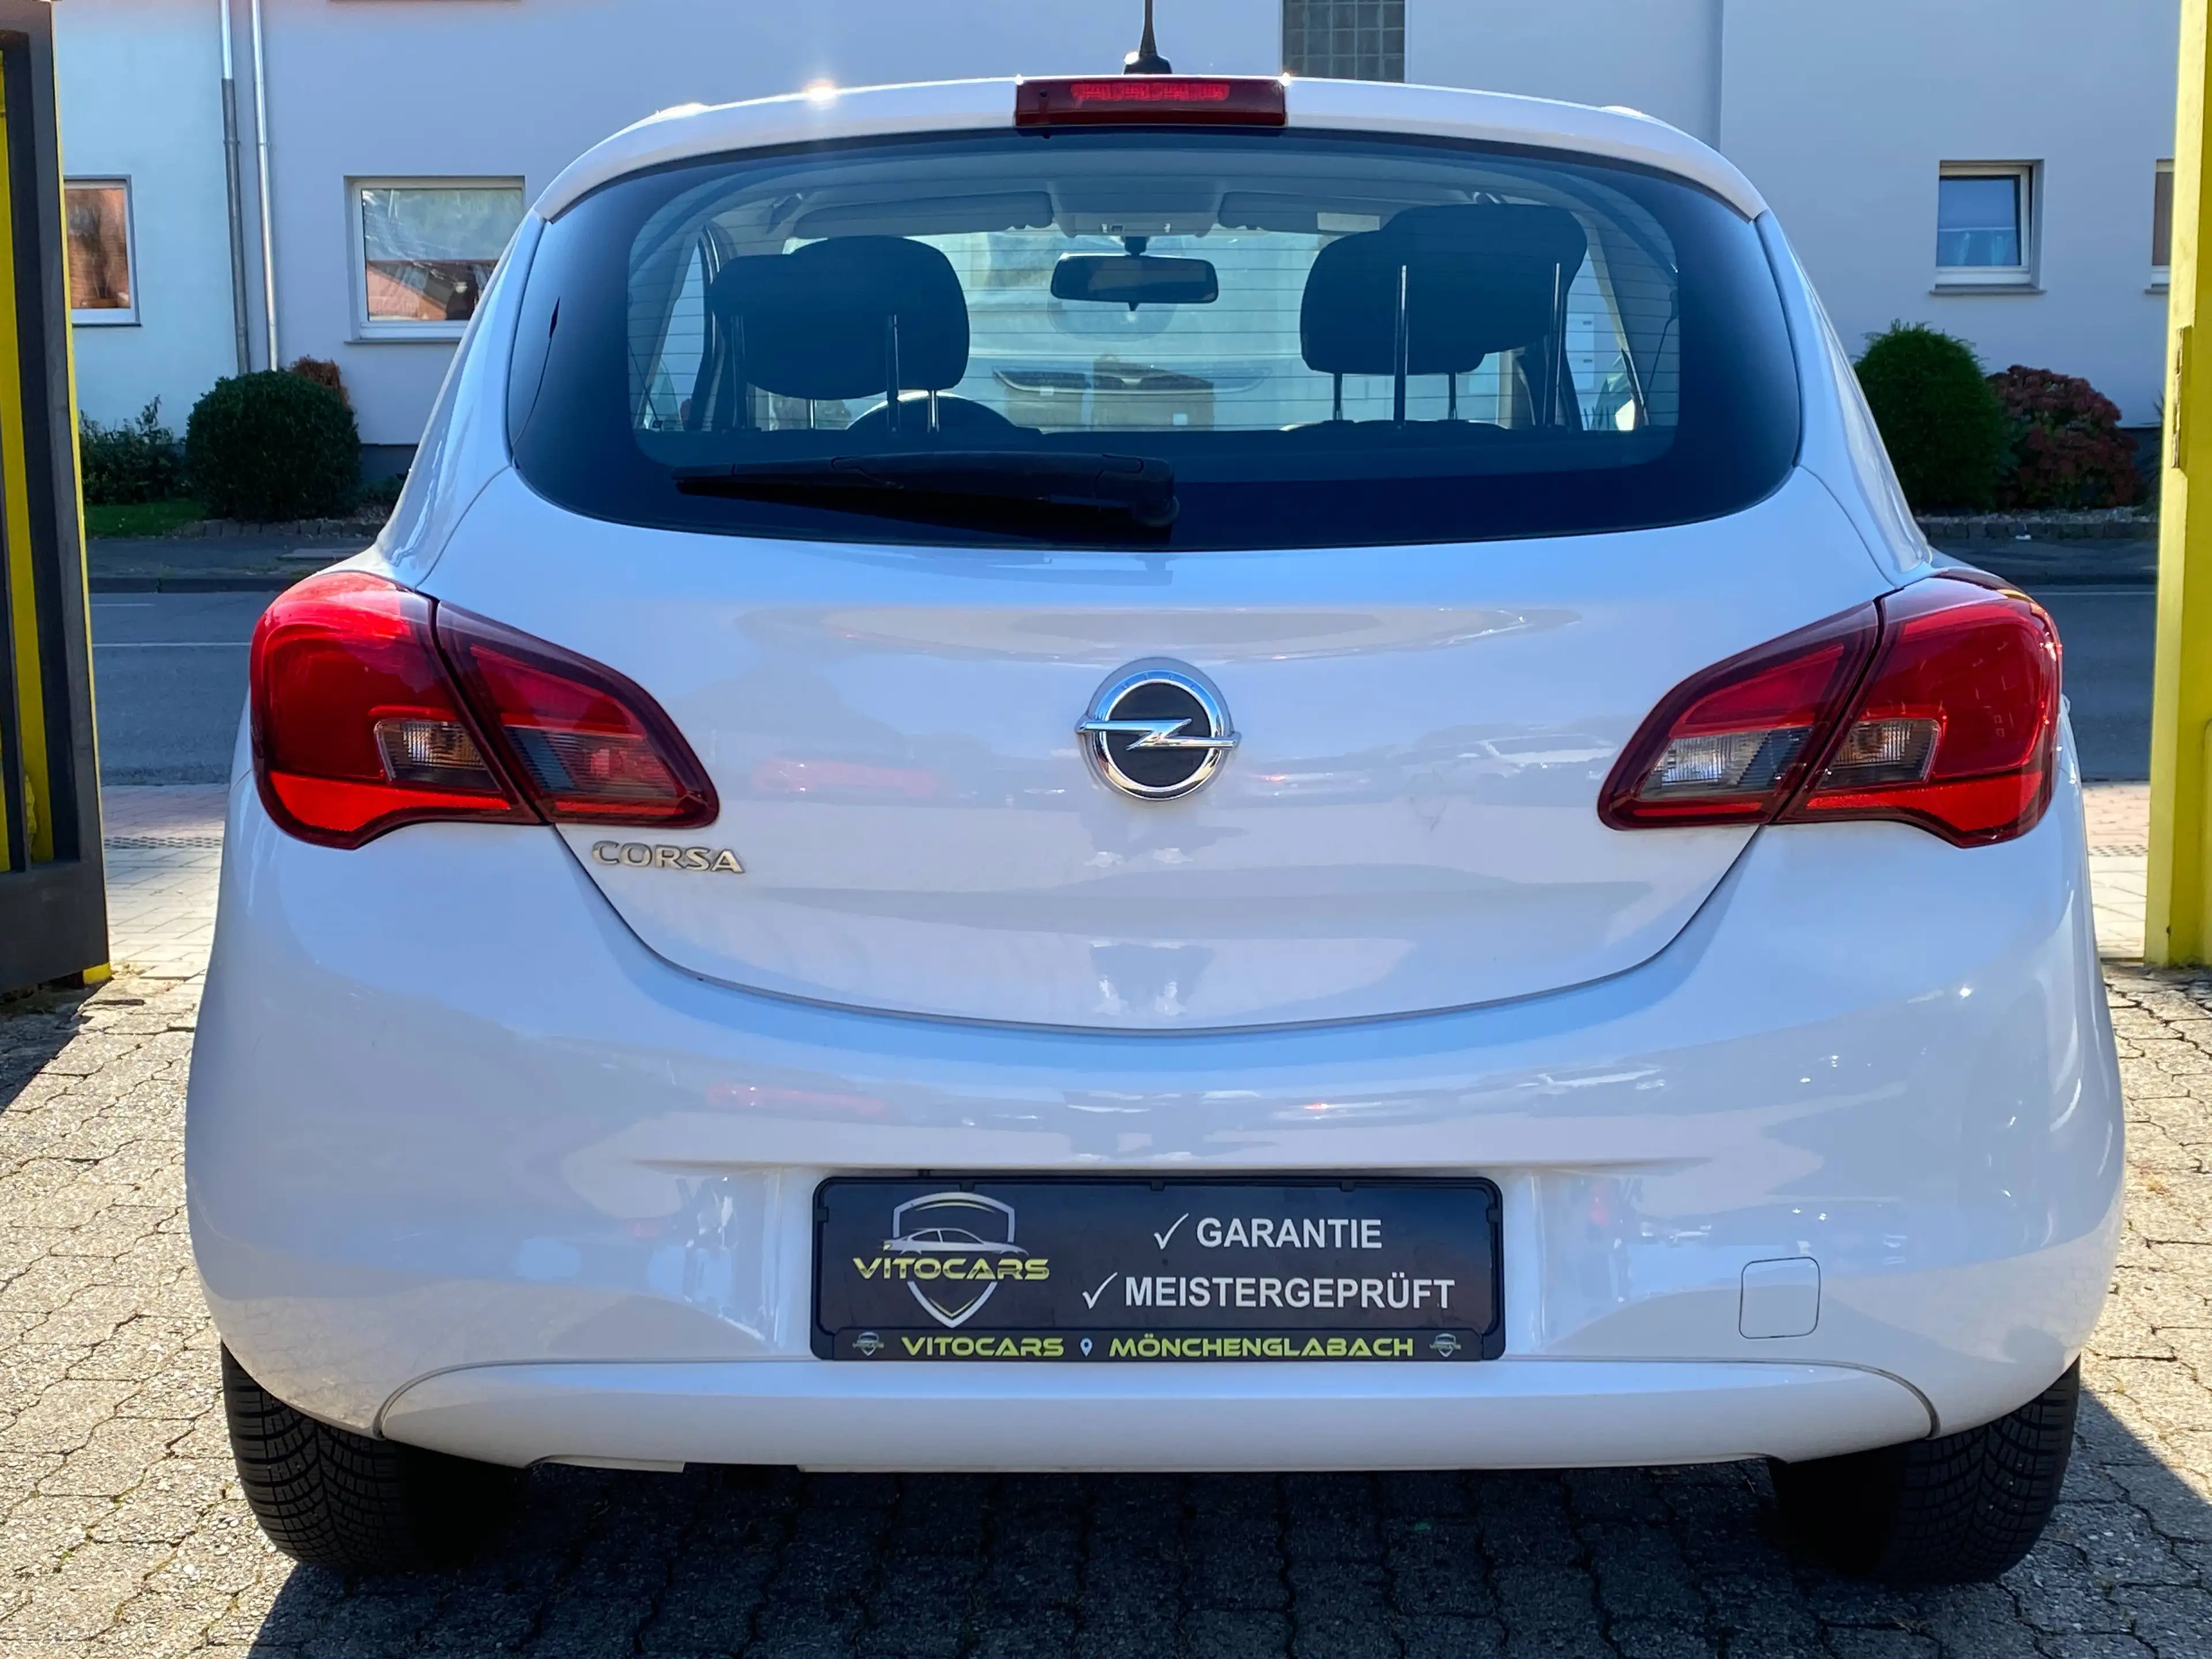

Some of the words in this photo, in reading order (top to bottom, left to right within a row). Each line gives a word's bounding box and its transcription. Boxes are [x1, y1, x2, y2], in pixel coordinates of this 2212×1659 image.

[592, 840, 745, 874] CORSA
[1196, 1217, 1382, 1249] GARANTIE
[853, 1257, 1050, 1280] VITOCARS
[1125, 1271, 1456, 1309] MEISTERGEPRÜFT
[901, 1336, 1065, 1357] VITOCARS
[1109, 1332, 1414, 1357] MÖNCHENGLABACH
